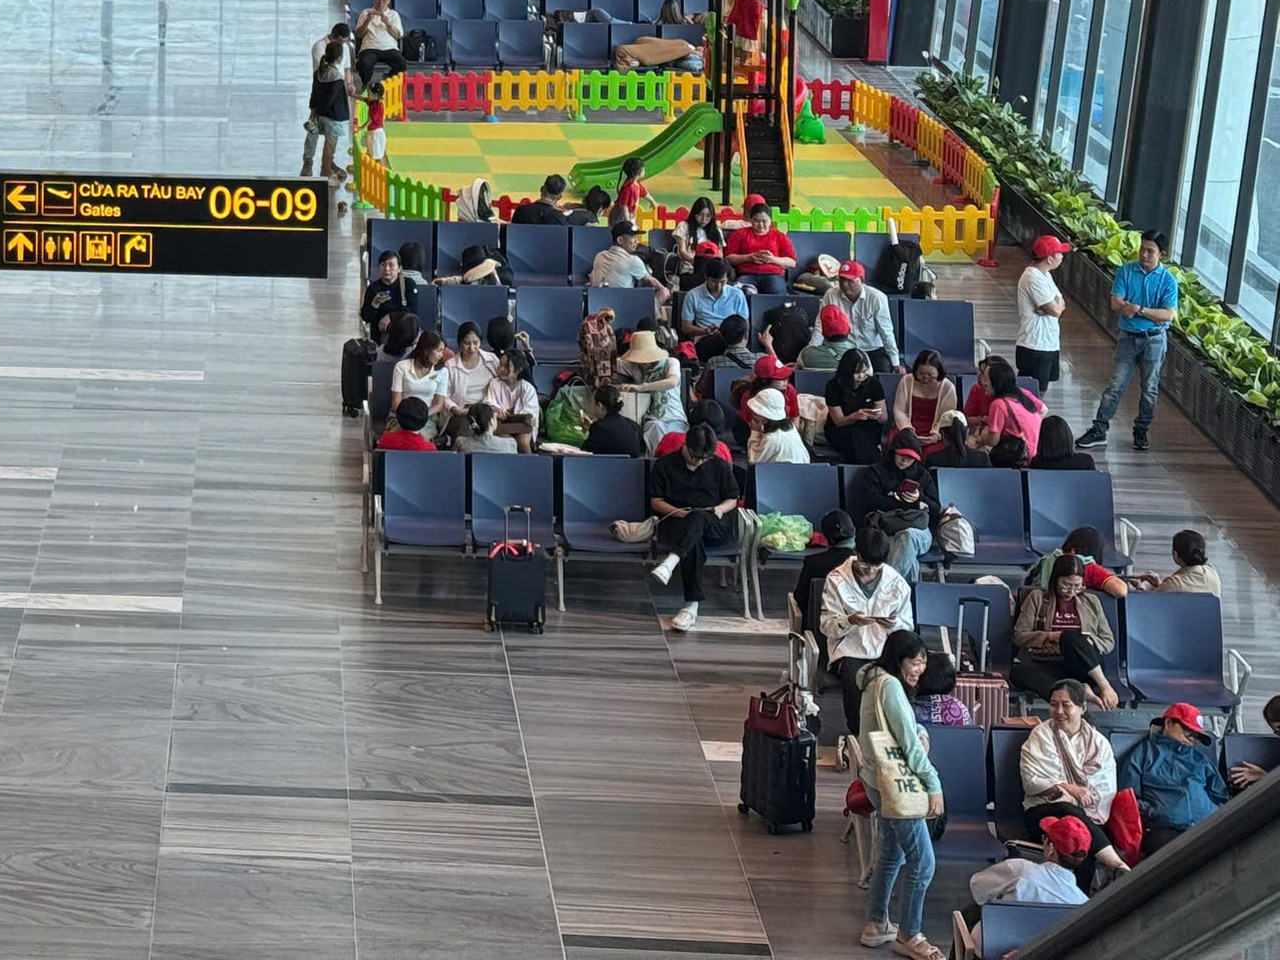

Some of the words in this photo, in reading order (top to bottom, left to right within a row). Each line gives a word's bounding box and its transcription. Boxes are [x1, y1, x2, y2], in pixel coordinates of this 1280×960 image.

[80, 181, 114, 198] CỬA
[118, 185, 139, 198] RA
[142, 183, 172, 199] TÀU
[176, 186, 206, 199] BAY
[209, 186, 317, 221] 06-09
[80, 204, 121, 217] Gates
[894, 779, 918, 792] THE
